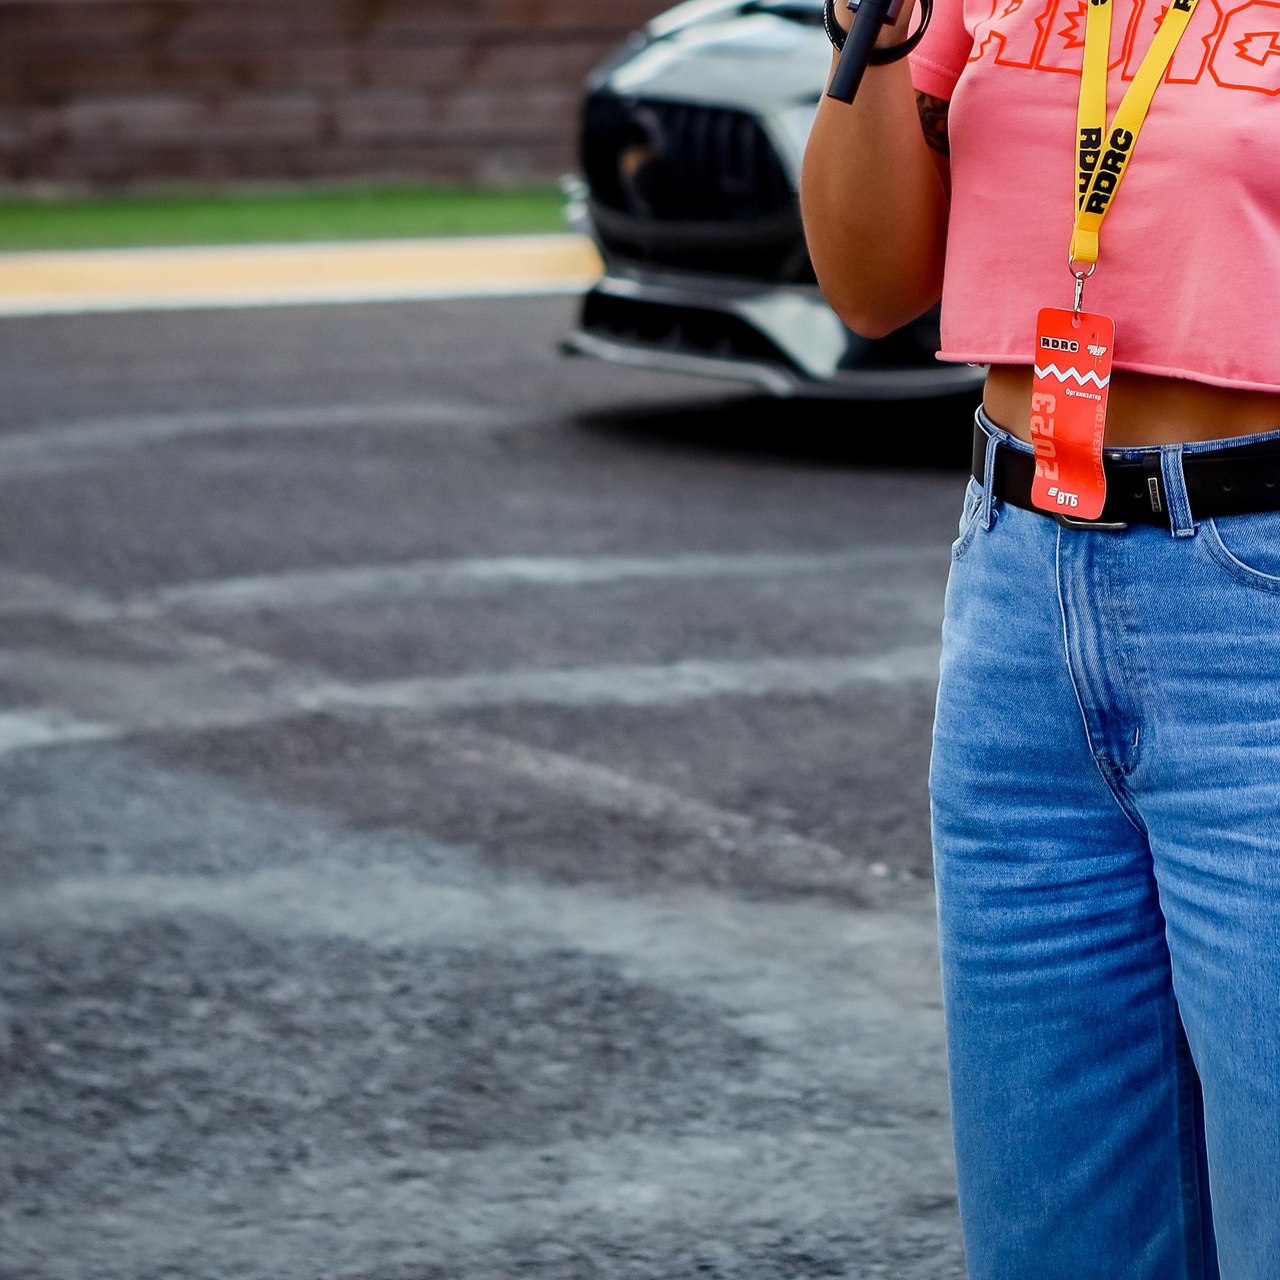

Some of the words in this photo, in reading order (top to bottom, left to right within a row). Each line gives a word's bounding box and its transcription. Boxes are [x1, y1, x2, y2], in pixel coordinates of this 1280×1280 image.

[1085, 127, 1134, 215] RDRC
[1040, 336, 1079, 353] RDRC
[1065, 387, 1102, 401] Организатор
[1030, 392, 1060, 481] 2023
[1056, 491, 1079, 507] ВТБ
